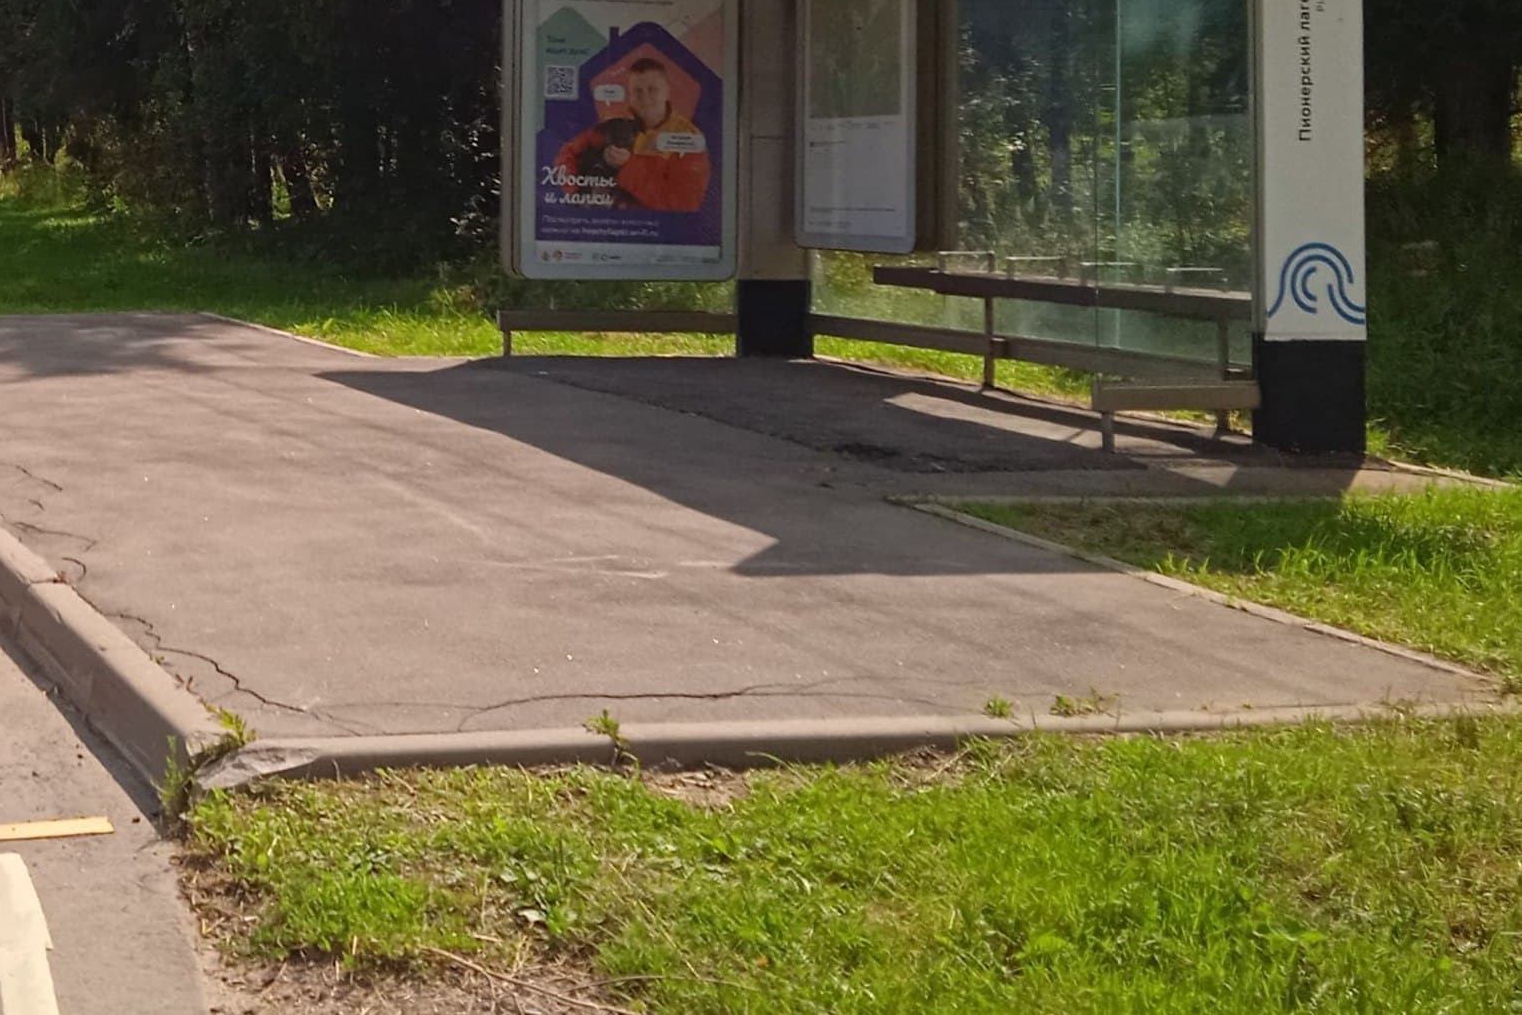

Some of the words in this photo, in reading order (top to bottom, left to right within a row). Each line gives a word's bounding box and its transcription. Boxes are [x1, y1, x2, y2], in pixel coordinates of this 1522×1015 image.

[1298, 36, 1312, 142] Пионерский
[541, 164, 617, 187] Хвосты
[544, 192, 557, 202] и
[559, 192, 615, 206] лапки
